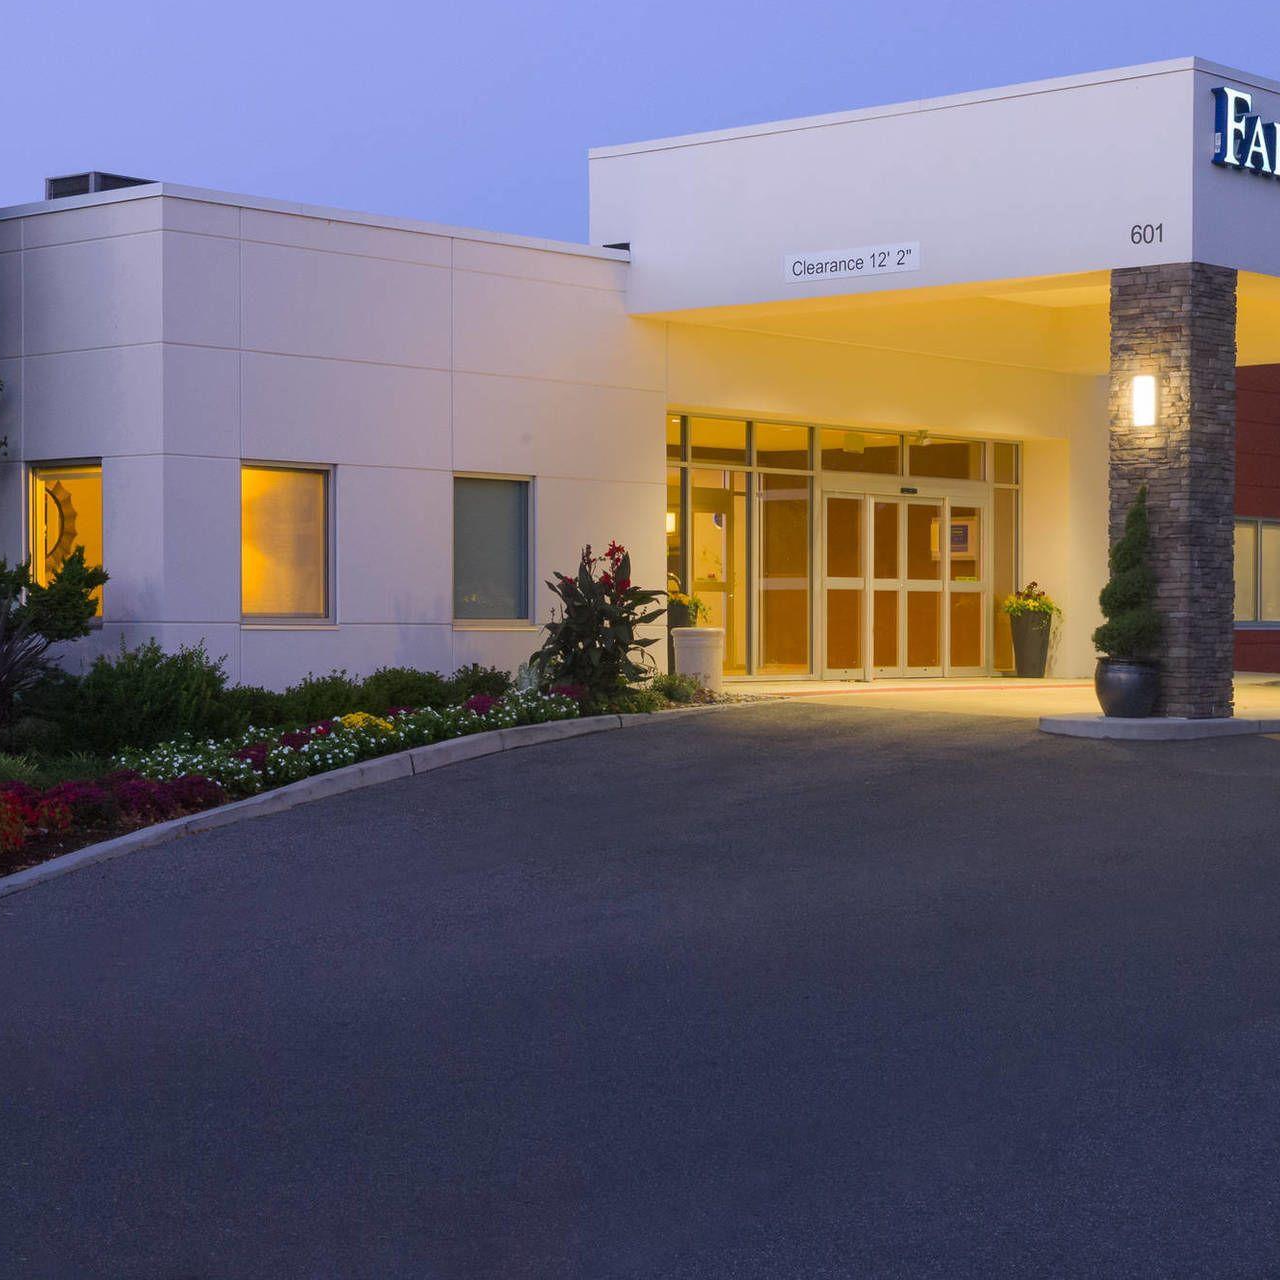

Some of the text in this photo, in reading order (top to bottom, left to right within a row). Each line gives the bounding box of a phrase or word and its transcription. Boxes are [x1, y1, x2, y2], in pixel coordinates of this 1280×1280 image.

[1131, 223, 1163, 244] 601
[792, 248, 912, 276] Clearance 12' 2"
